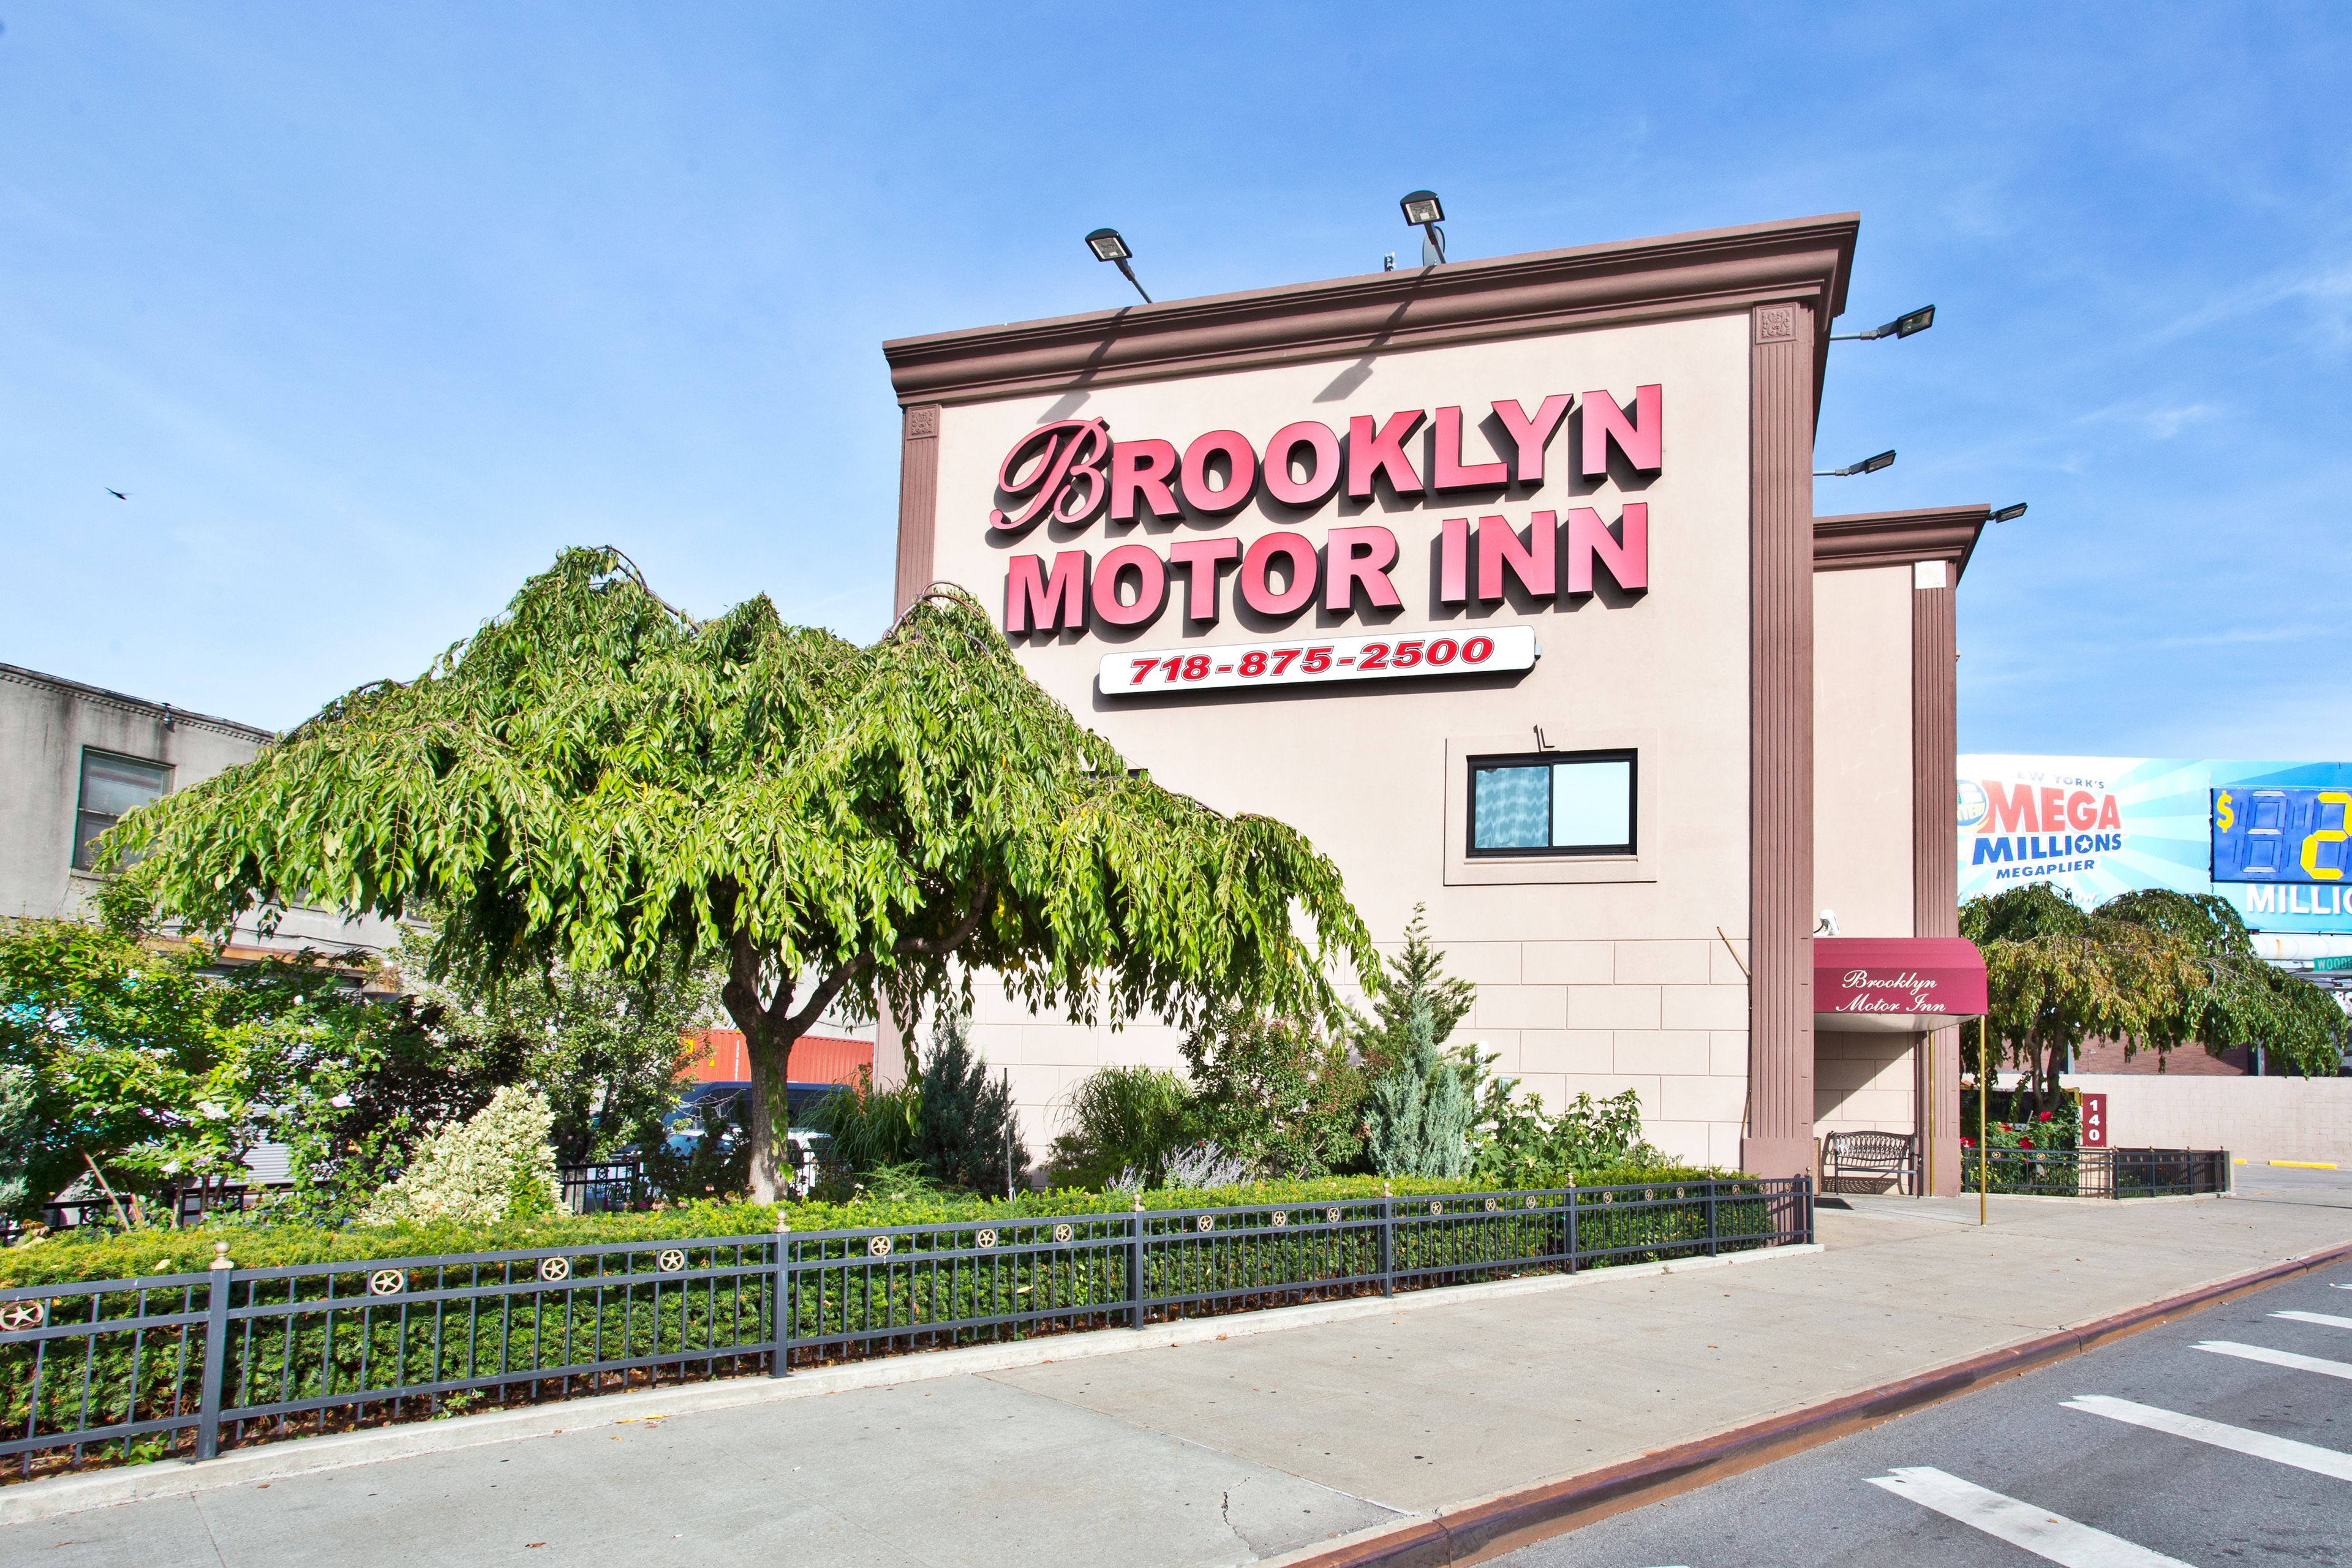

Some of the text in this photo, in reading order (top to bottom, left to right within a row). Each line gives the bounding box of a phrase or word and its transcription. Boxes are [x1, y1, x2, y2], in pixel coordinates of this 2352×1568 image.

[989, 383, 1662, 533] BROOKLYN
[1006, 502, 1648, 636] MOTOR INN
[1129, 636, 1494, 685] 718-875-2500
[2053, 774, 2105, 790] YORK'S
[1976, 779, 2121, 834] MEGA
[1972, 833, 2122, 865] MILLIONS
[1996, 859, 2095, 880] MEGAPLIER
[1842, 970, 1937, 995] Brooklyn
[1835, 993, 1947, 1012] Motor Inn
[2089, 1099, 2100, 1141] 140
